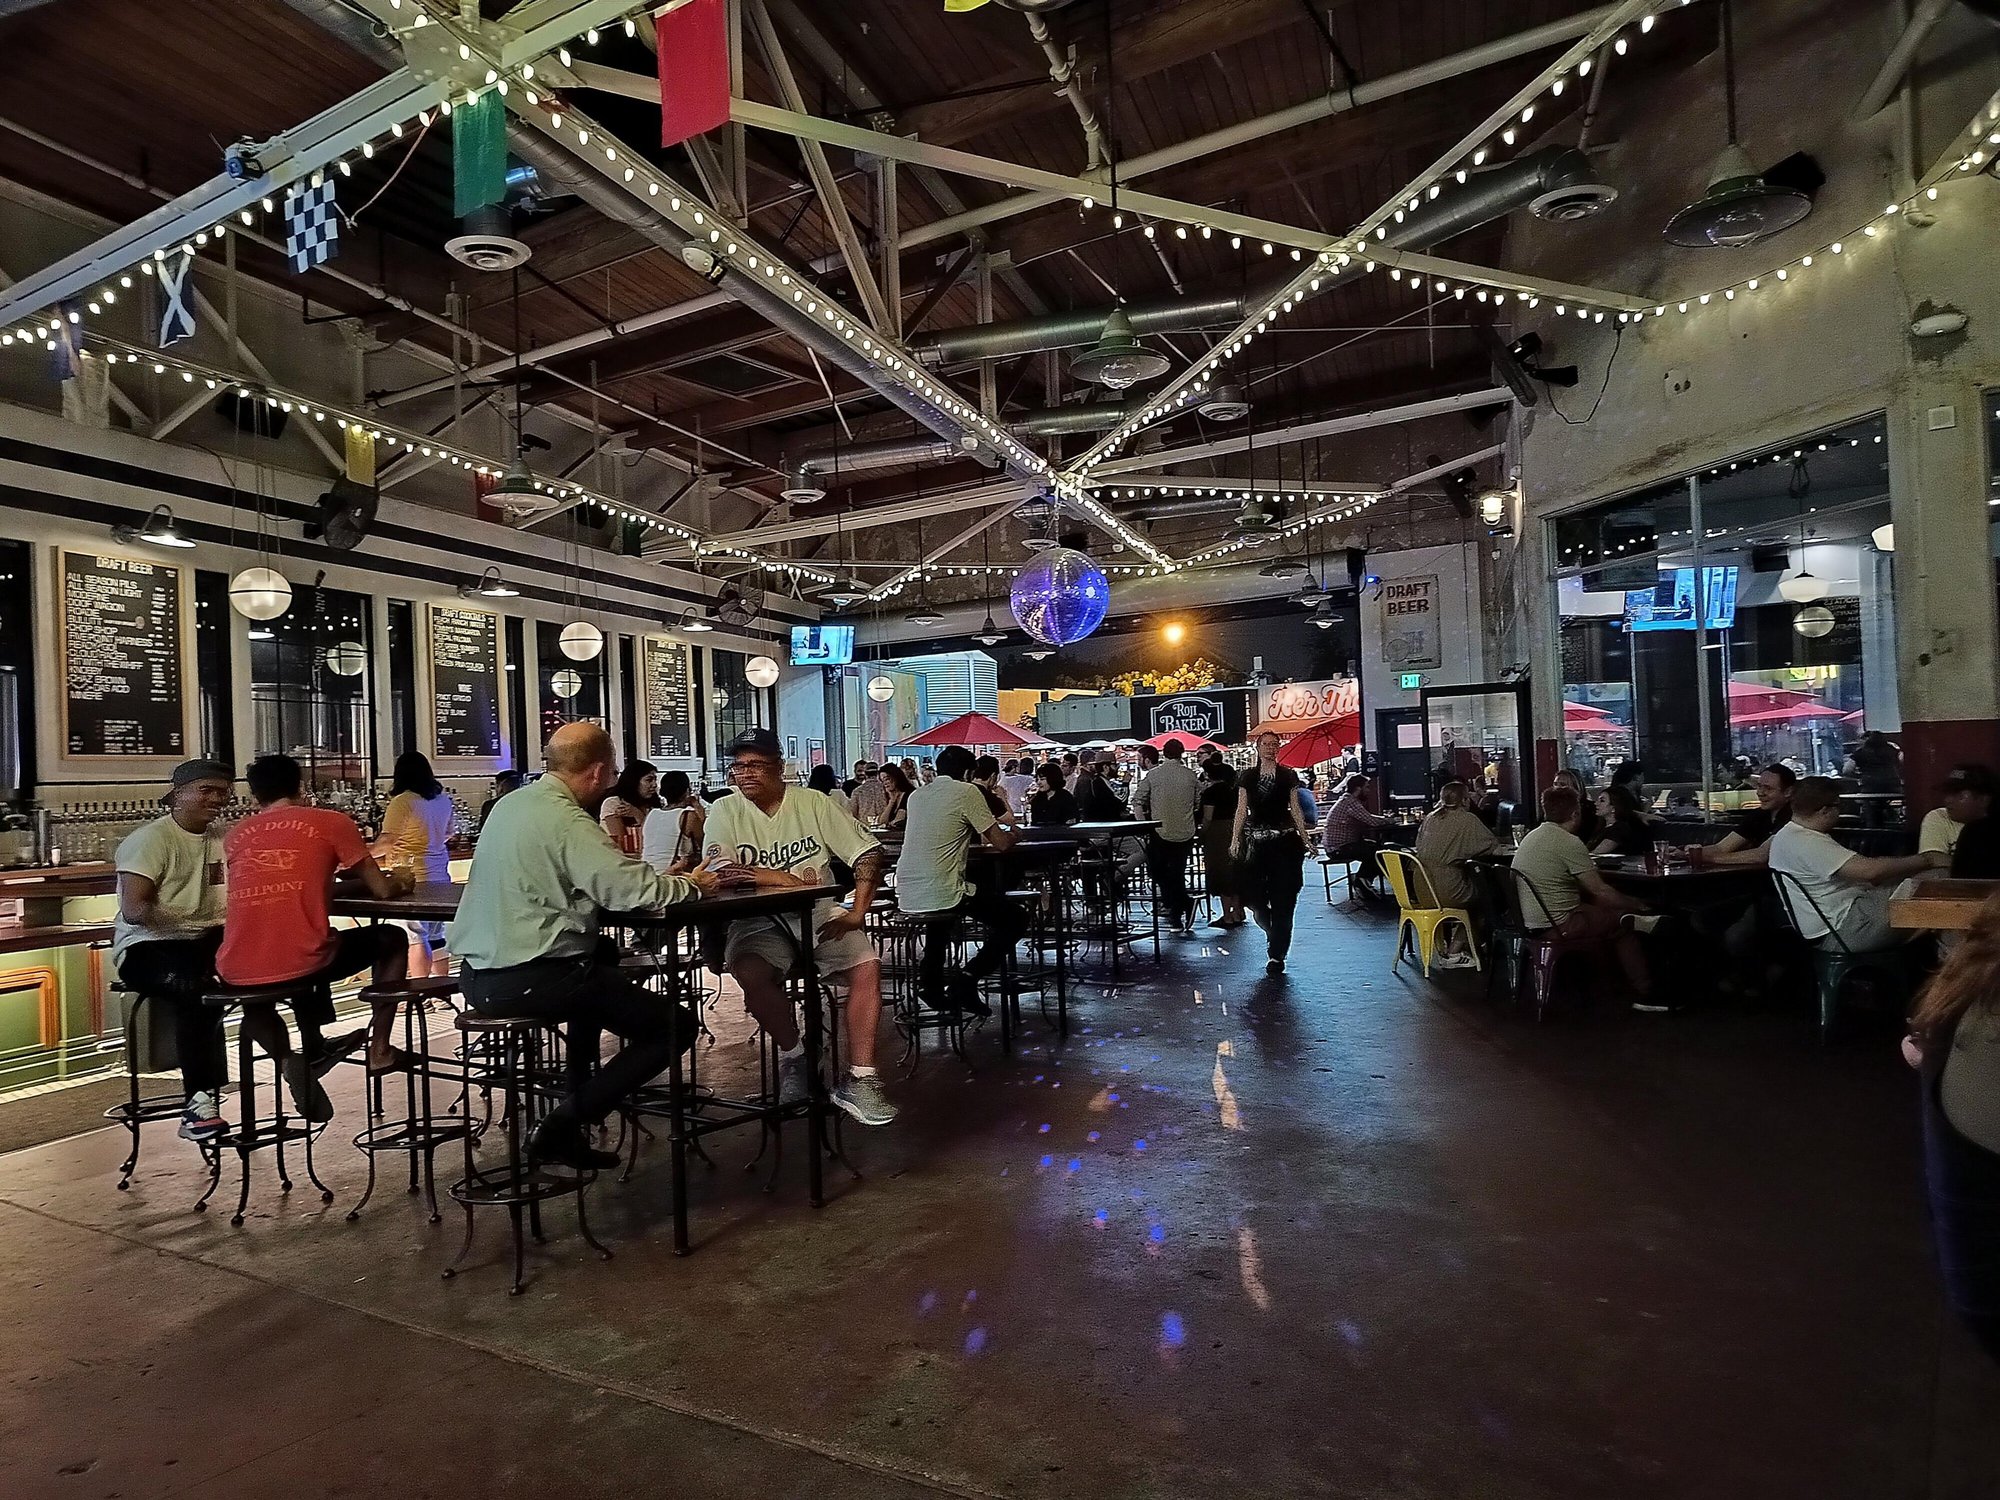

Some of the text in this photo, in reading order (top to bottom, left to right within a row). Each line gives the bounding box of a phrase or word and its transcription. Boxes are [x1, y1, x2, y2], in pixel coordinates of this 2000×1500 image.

[96, 556, 127, 571] DRAFT
[128, 562, 153, 575] BEER
[67, 572, 83, 583] ALL
[84, 574, 118, 588] SEASON
[84, 583, 118, 596] SEASON
[1387, 582, 1430, 598] DRAFT
[1387, 599, 1430, 616] BEER
[1160, 713, 1212, 732] BAKERY
[737, 835, 821, 869] Dodgers
